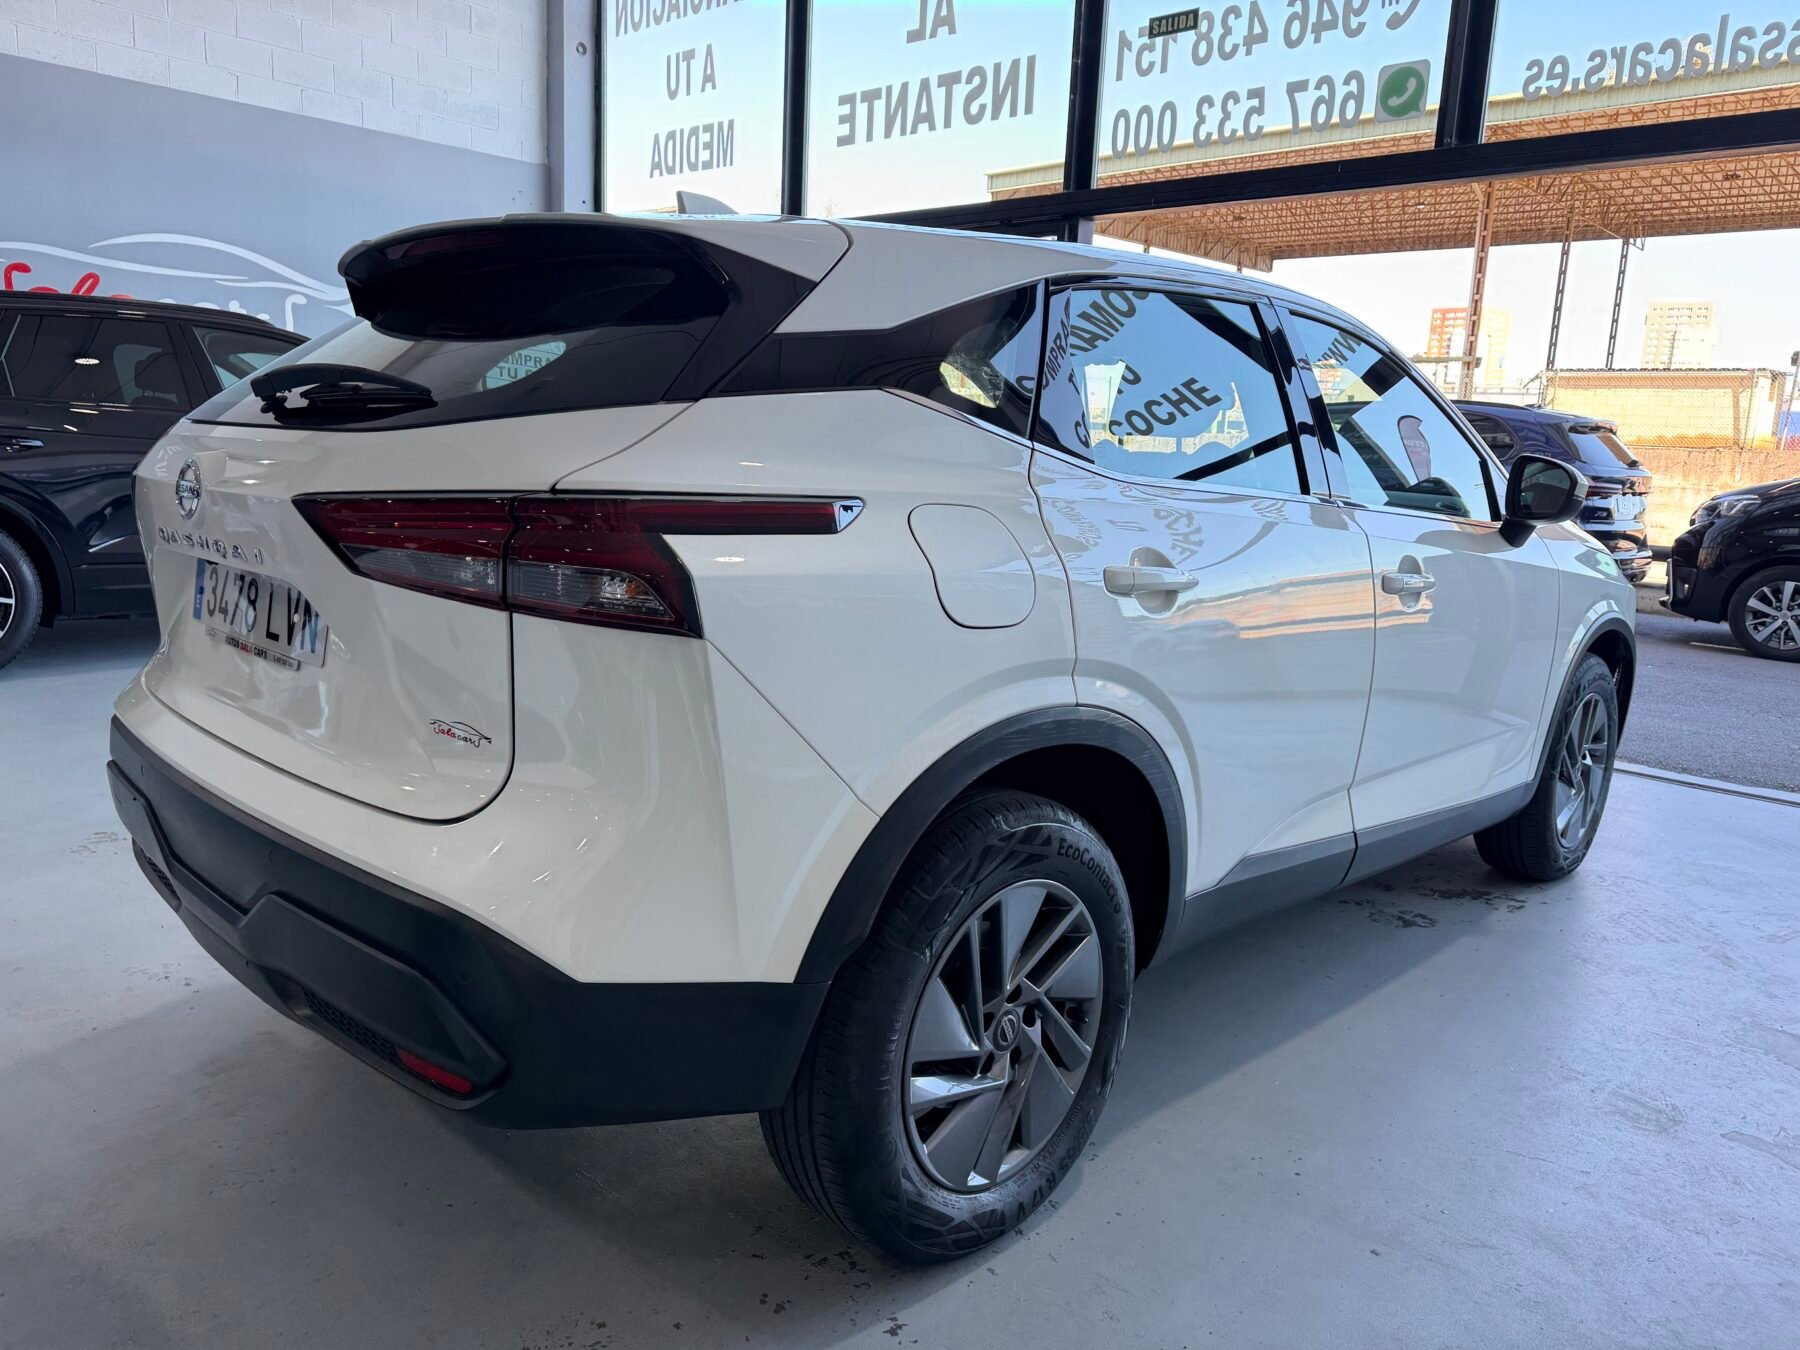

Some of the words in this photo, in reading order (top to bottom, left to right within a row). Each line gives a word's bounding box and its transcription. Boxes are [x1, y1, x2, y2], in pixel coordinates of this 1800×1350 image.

[1151, 14, 1195, 36] SALIDA
[158, 526, 264, 565] QASHQAI
[206, 564, 259, 633] 3478
[265, 582, 321, 655] LVN
